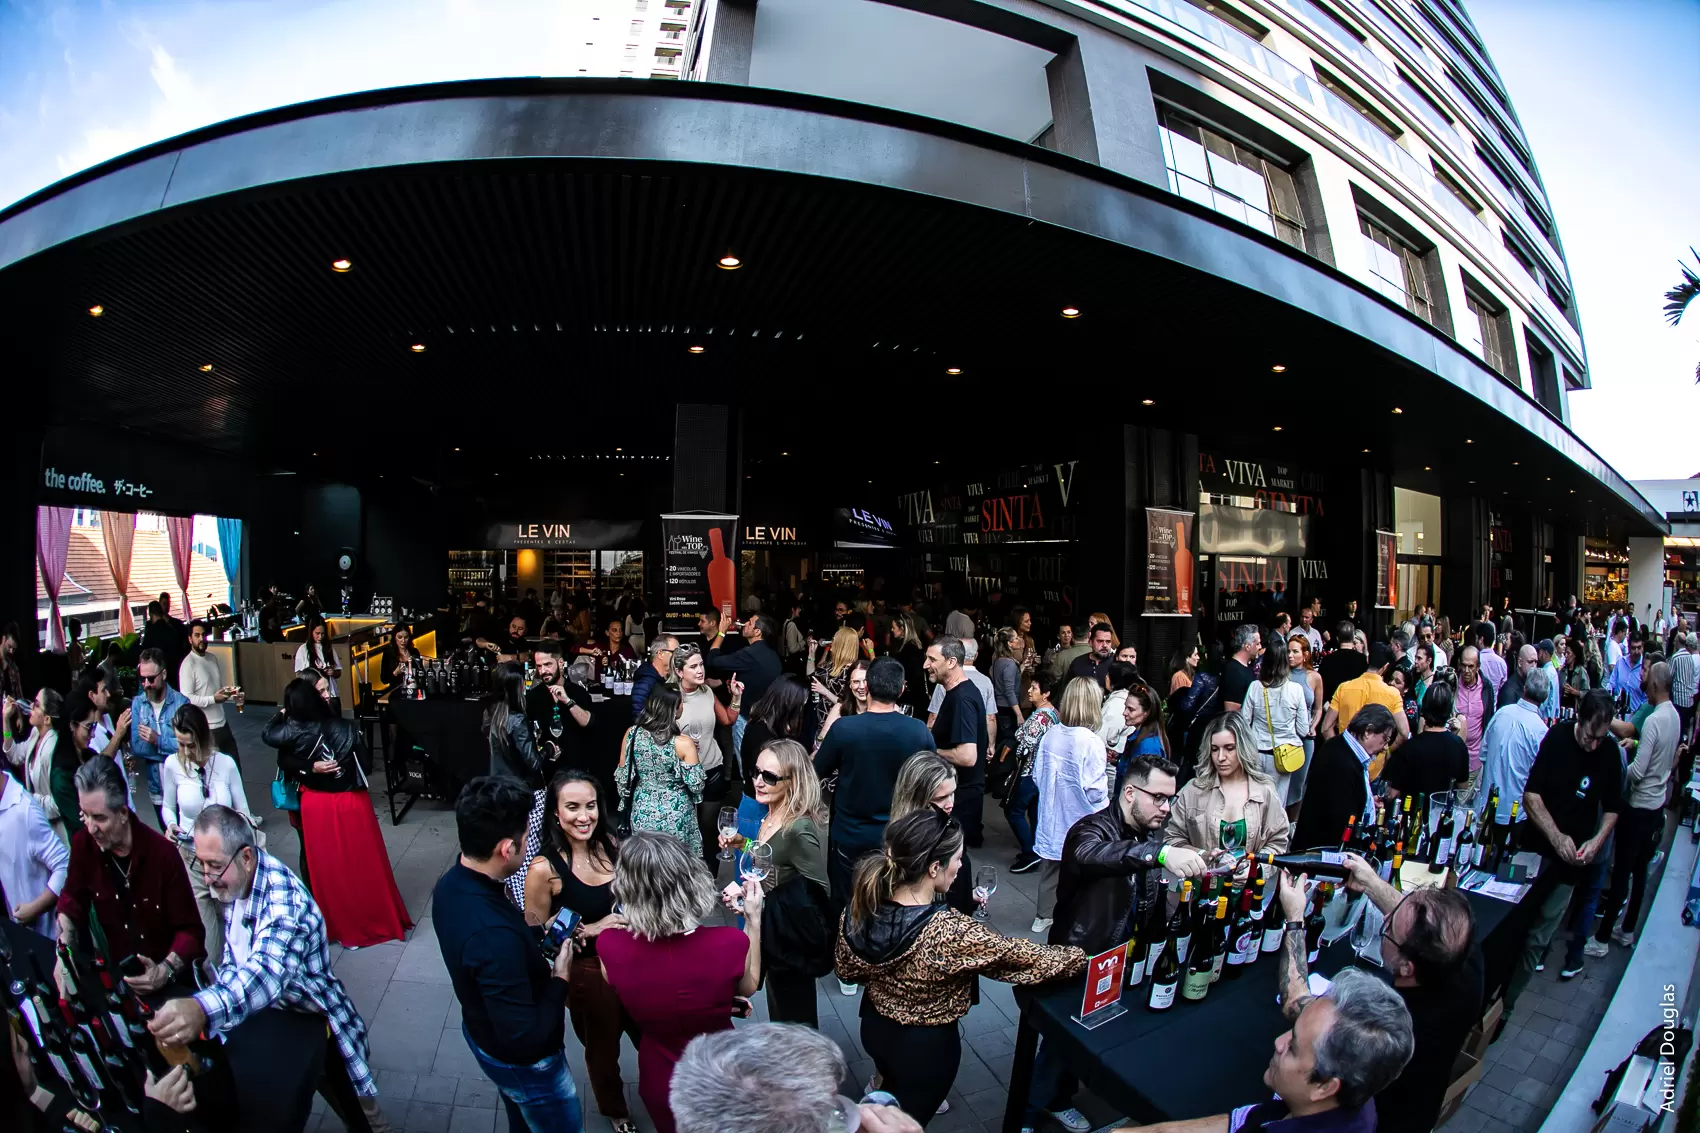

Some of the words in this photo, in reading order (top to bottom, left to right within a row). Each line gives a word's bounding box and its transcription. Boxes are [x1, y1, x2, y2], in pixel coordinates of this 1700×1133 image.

[1224, 459, 1267, 488] VIVA
[1276, 466, 1288, 476] TOP
[44, 467, 66, 489] the
[67, 471, 106, 495] coffee.
[1271, 477, 1295, 489] MARKET
[966, 482, 984, 497] VIVA
[897, 488, 936, 526] VIVA
[981, 491, 1046, 533] SINTA
[852, 508, 874, 524] LE
[872, 514, 893, 531] VIN
[518, 524, 539, 538] LE
[542, 524, 571, 538] VIN
[746, 526, 766, 540] LE
[770, 527, 796, 541] VIN
[917, 529, 933, 543] VIVA
[1158, 526, 1173, 534] Wine
[682, 535, 703, 543] Wine
[963, 532, 979, 544] VIVA
[686, 542, 704, 550] TOP
[1219, 558, 1285, 593] SINTA
[1301, 559, 1328, 579] VIVA
[1225, 598, 1238, 608] TOP
